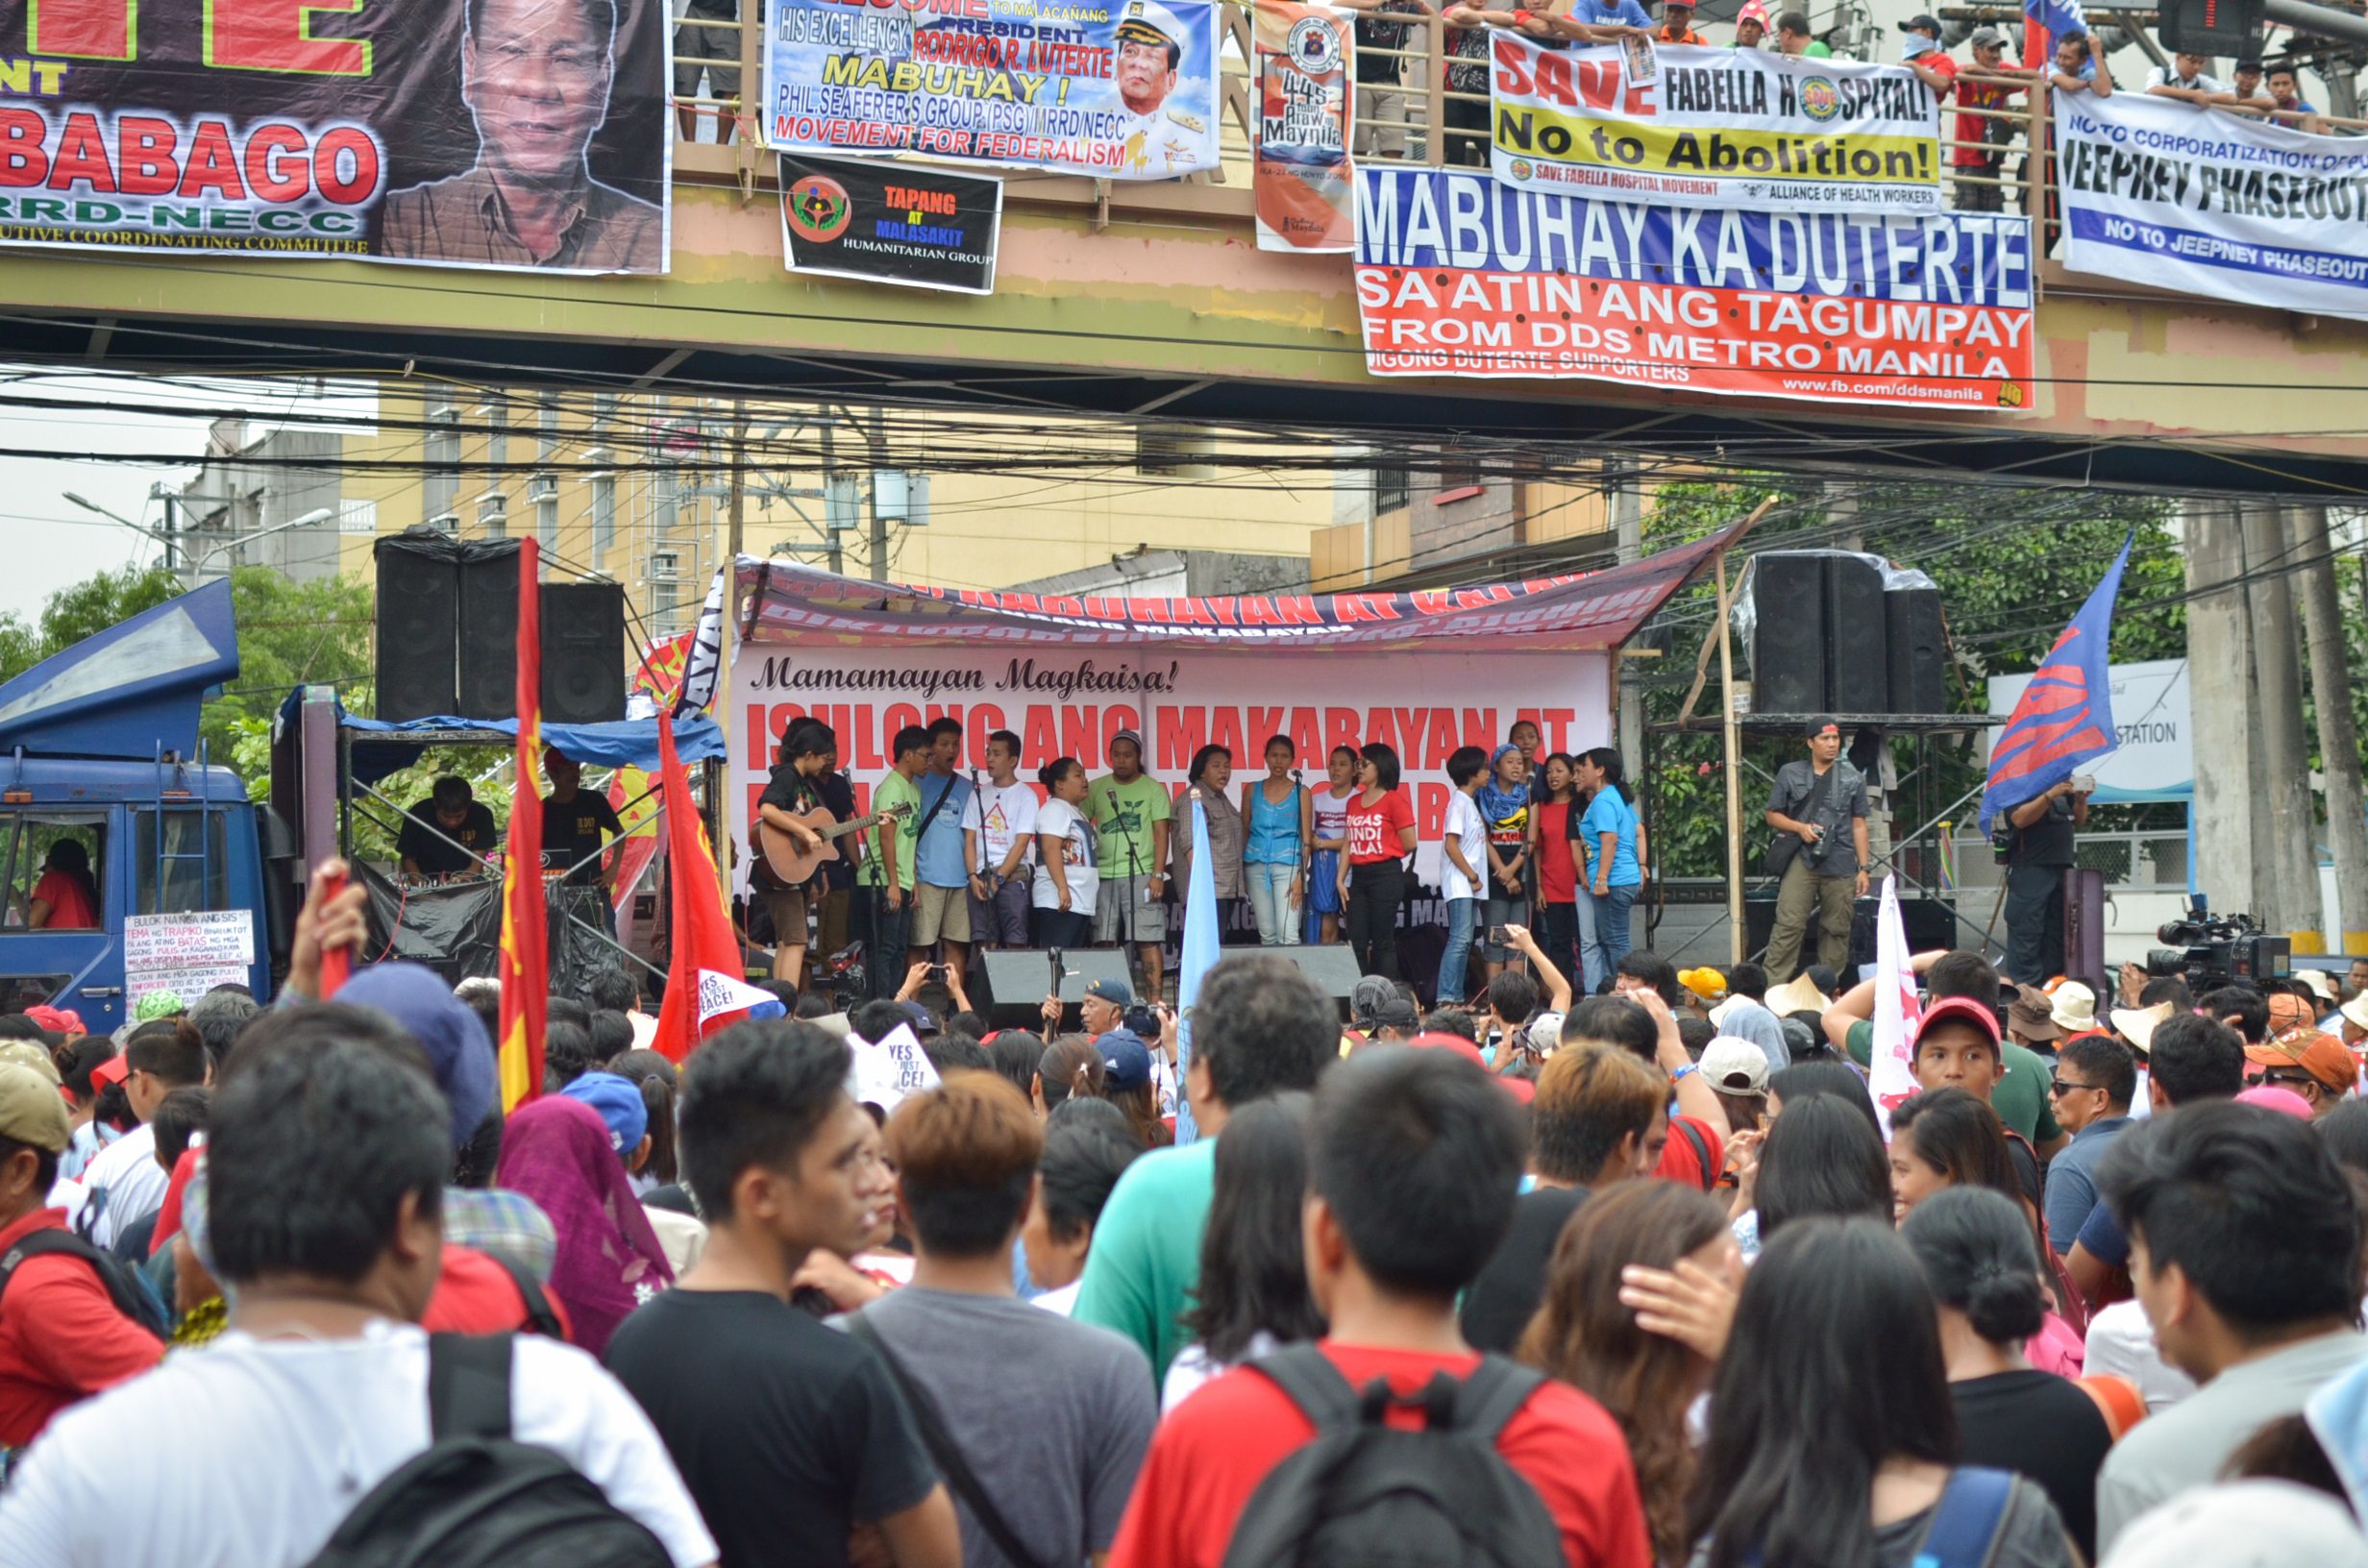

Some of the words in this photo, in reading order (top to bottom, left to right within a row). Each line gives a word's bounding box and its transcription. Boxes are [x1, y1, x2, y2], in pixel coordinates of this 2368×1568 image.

[994, 2, 1010, 15] TO
[1014, 4, 1109, 23] MALACAÑANG
[779, 7, 806, 41] HIS
[808, 9, 910, 52] EXCELLENCY
[939, 16, 1088, 44] PRESIDENT
[912, 29, 1000, 69] RODRIGO
[1003, 39, 1022, 71] R.
[1027, 40, 1113, 79] DUTERTE
[822, 54, 1048, 104] MABUHAY
[1283, 69, 1326, 106] 445
[1494, 38, 1657, 116] SAVE
[1665, 66, 1768, 115] FABELLA
[925, 96, 984, 129] GROUP
[776, 115, 915, 146] MOVEMENT
[920, 128, 971, 155] FOR
[975, 133, 1126, 167] FEDERALISM
[1265, 119, 1341, 147] Maynila
[1498, 109, 1572, 156] No
[1589, 126, 1644, 165] to
[1665, 131, 1930, 179] Abolition!
[2134, 129, 2317, 171] CORPORATIZATION
[1536, 163, 1563, 181] SAVE
[1565, 167, 1608, 186] FABELLA
[1611, 173, 1660, 192] HOSPITAL
[1662, 177, 1718, 196] MOVEMENT
[1769, 185, 1820, 201] ALLIANCE
[1823, 188, 1837, 201] OF
[1839, 190, 1881, 202] HEALTH
[1884, 191, 1935, 205] WORKERS
[884, 185, 957, 215] TAPANG
[876, 219, 964, 247] MALASAKIT
[907, 210, 924, 226] AT
[69, 228, 240, 250] COORDINATING
[244, 235, 369, 254] COMMITTEE
[843, 238, 946, 259] HUMANITARIAN
[948, 252, 994, 265] GROUP
[1355, 171, 1651, 280] MABUHAY
[1670, 206, 1758, 290] KA
[1769, 213, 2030, 307] DUTERTE
[2105, 219, 2135, 241] NO
[2140, 227, 2165, 248] TO
[2170, 233, 2257, 265] JEEPNEY
[2262, 250, 2368, 282] PHASEOUT
[1357, 269, 1439, 308] SA
[1450, 274, 1584, 314] ATIN
[1597, 283, 1718, 329] ANG
[1738, 293, 2032, 348] TAGUMPAY
[1366, 318, 1512, 347] FROM
[1531, 322, 1632, 354] DDS
[1647, 332, 1822, 369] METRO
[1837, 347, 2012, 379] MANILA
[1454, 349, 1554, 370] DUTERTE
[1559, 352, 1690, 382] SUPPORTERS
[1783, 378, 1984, 402] www.fb.com/ddsmanila
[750, 656, 984, 699] Mamamayan
[996, 657, 1179, 701] Magkaisa!
[1156, 705, 1497, 771] MAKABAYAN
[2115, 722, 2176, 746] STATION
[888, 1043, 913, 1062] YES
